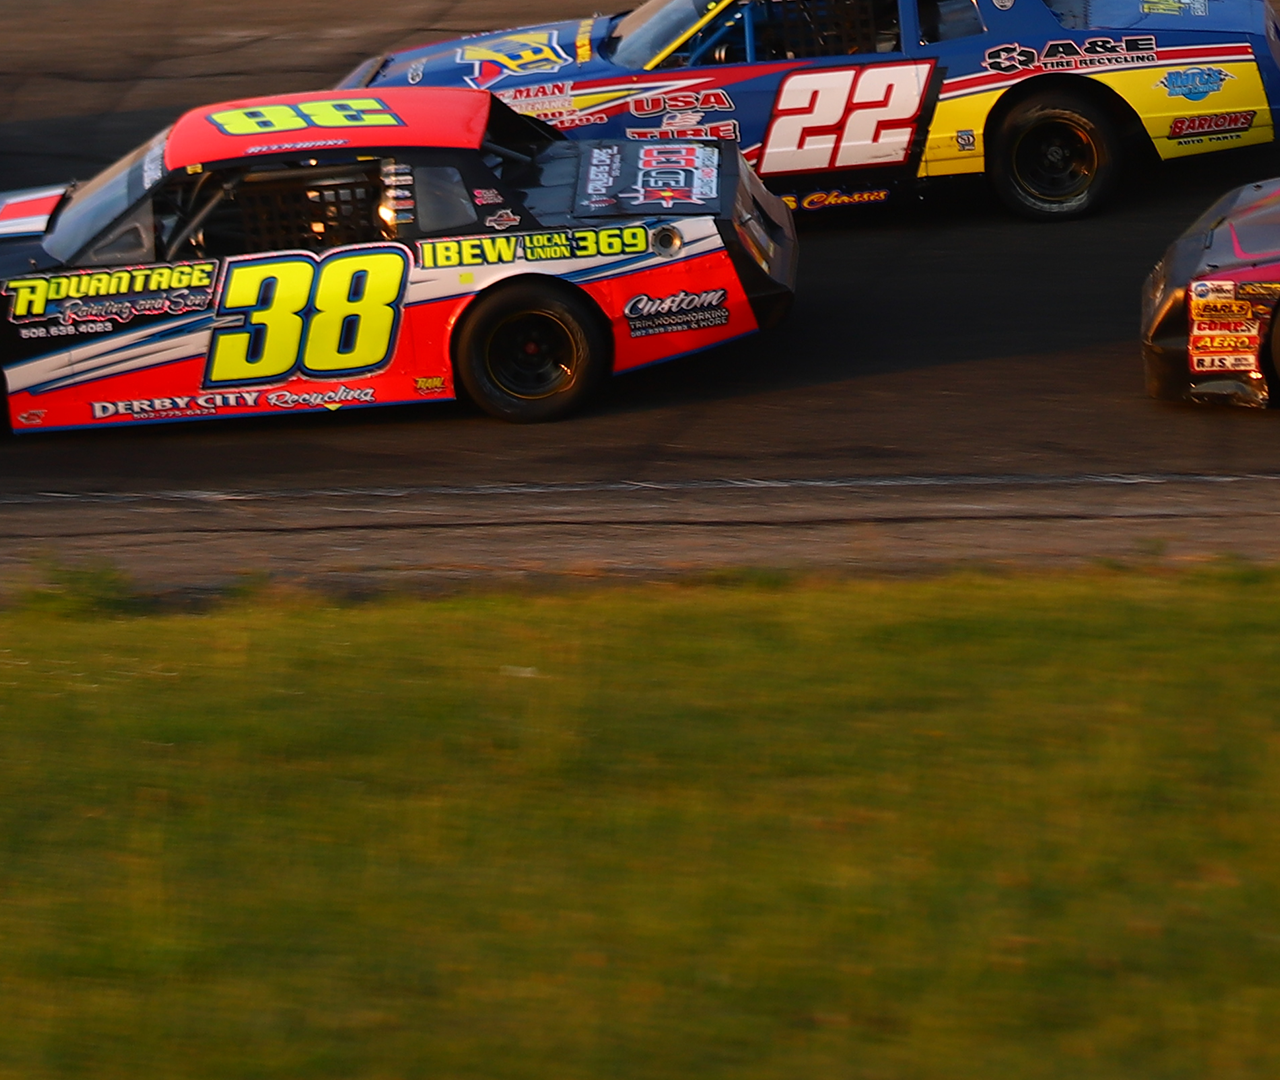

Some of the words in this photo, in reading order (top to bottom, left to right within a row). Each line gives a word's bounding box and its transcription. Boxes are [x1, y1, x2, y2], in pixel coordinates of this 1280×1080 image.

[1042, 60, 1074, 69] TIRE
[1079, 54, 1156, 67] RECYCLING
[512, 82, 567, 100] MAN
[631, 89, 734, 117] USA
[206, 98, 408, 135] 38
[757, 61, 934, 175] 22
[1168, 110, 1257, 139] BARLOWS
[802, 190, 889, 210] Chassis
[422, 236, 518, 269] IBEW
[524, 233, 570, 248] LOCAL
[525, 247, 571, 262] UNION
[573, 227, 649, 257] 369
[206, 249, 410, 387] 38
[624, 290, 726, 318] Custom
[1197, 337, 1250, 348] AERO
[92, 396, 194, 419] DERBY
[196, 391, 264, 410] CITY
[267, 385, 376, 408] Recycling
